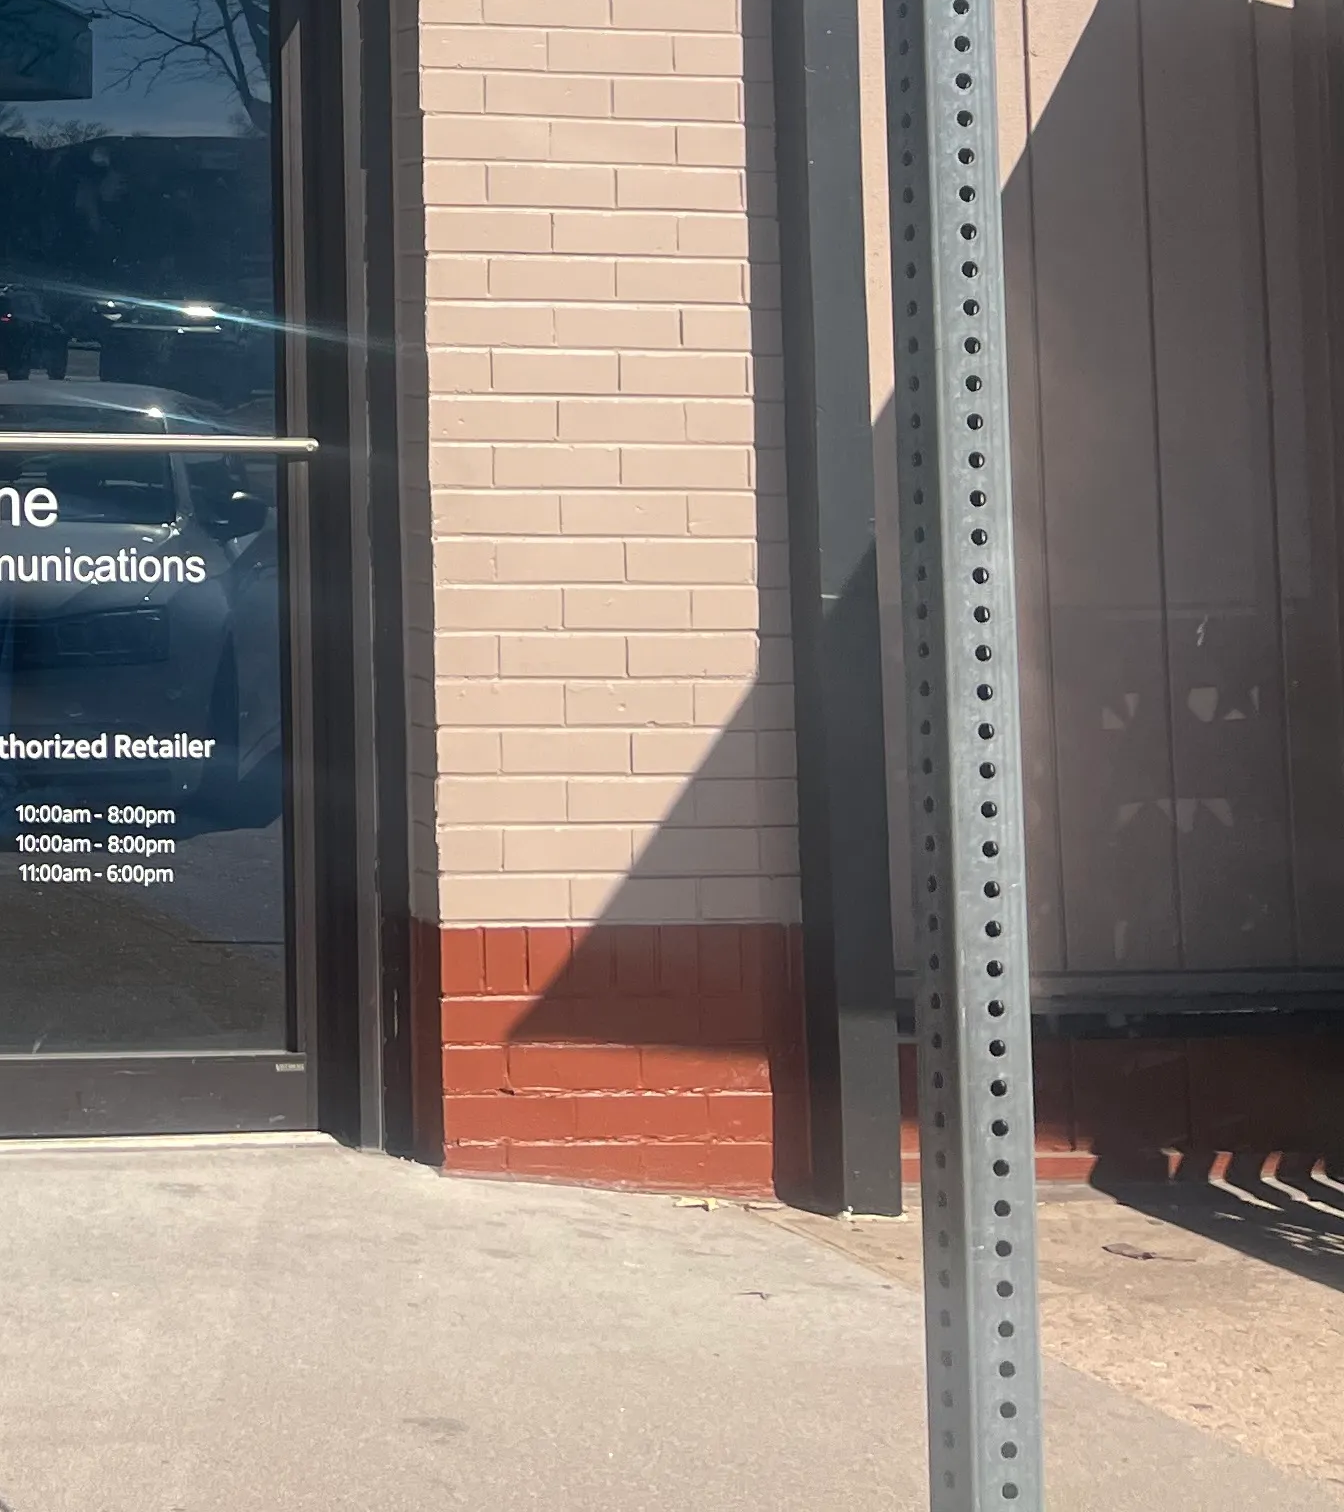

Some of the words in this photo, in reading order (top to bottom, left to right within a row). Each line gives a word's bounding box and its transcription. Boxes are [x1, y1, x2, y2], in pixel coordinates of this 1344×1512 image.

[114, 733, 216, 759] Retailer
[15, 804, 91, 824] 10:00am
[107, 805, 176, 828] 8:00pm
[15, 834, 91, 853] 10:00am
[107, 834, 176, 857] 8:00pm
[18, 863, 91, 882] 11:00am
[106, 863, 174, 886] 6:00pm
